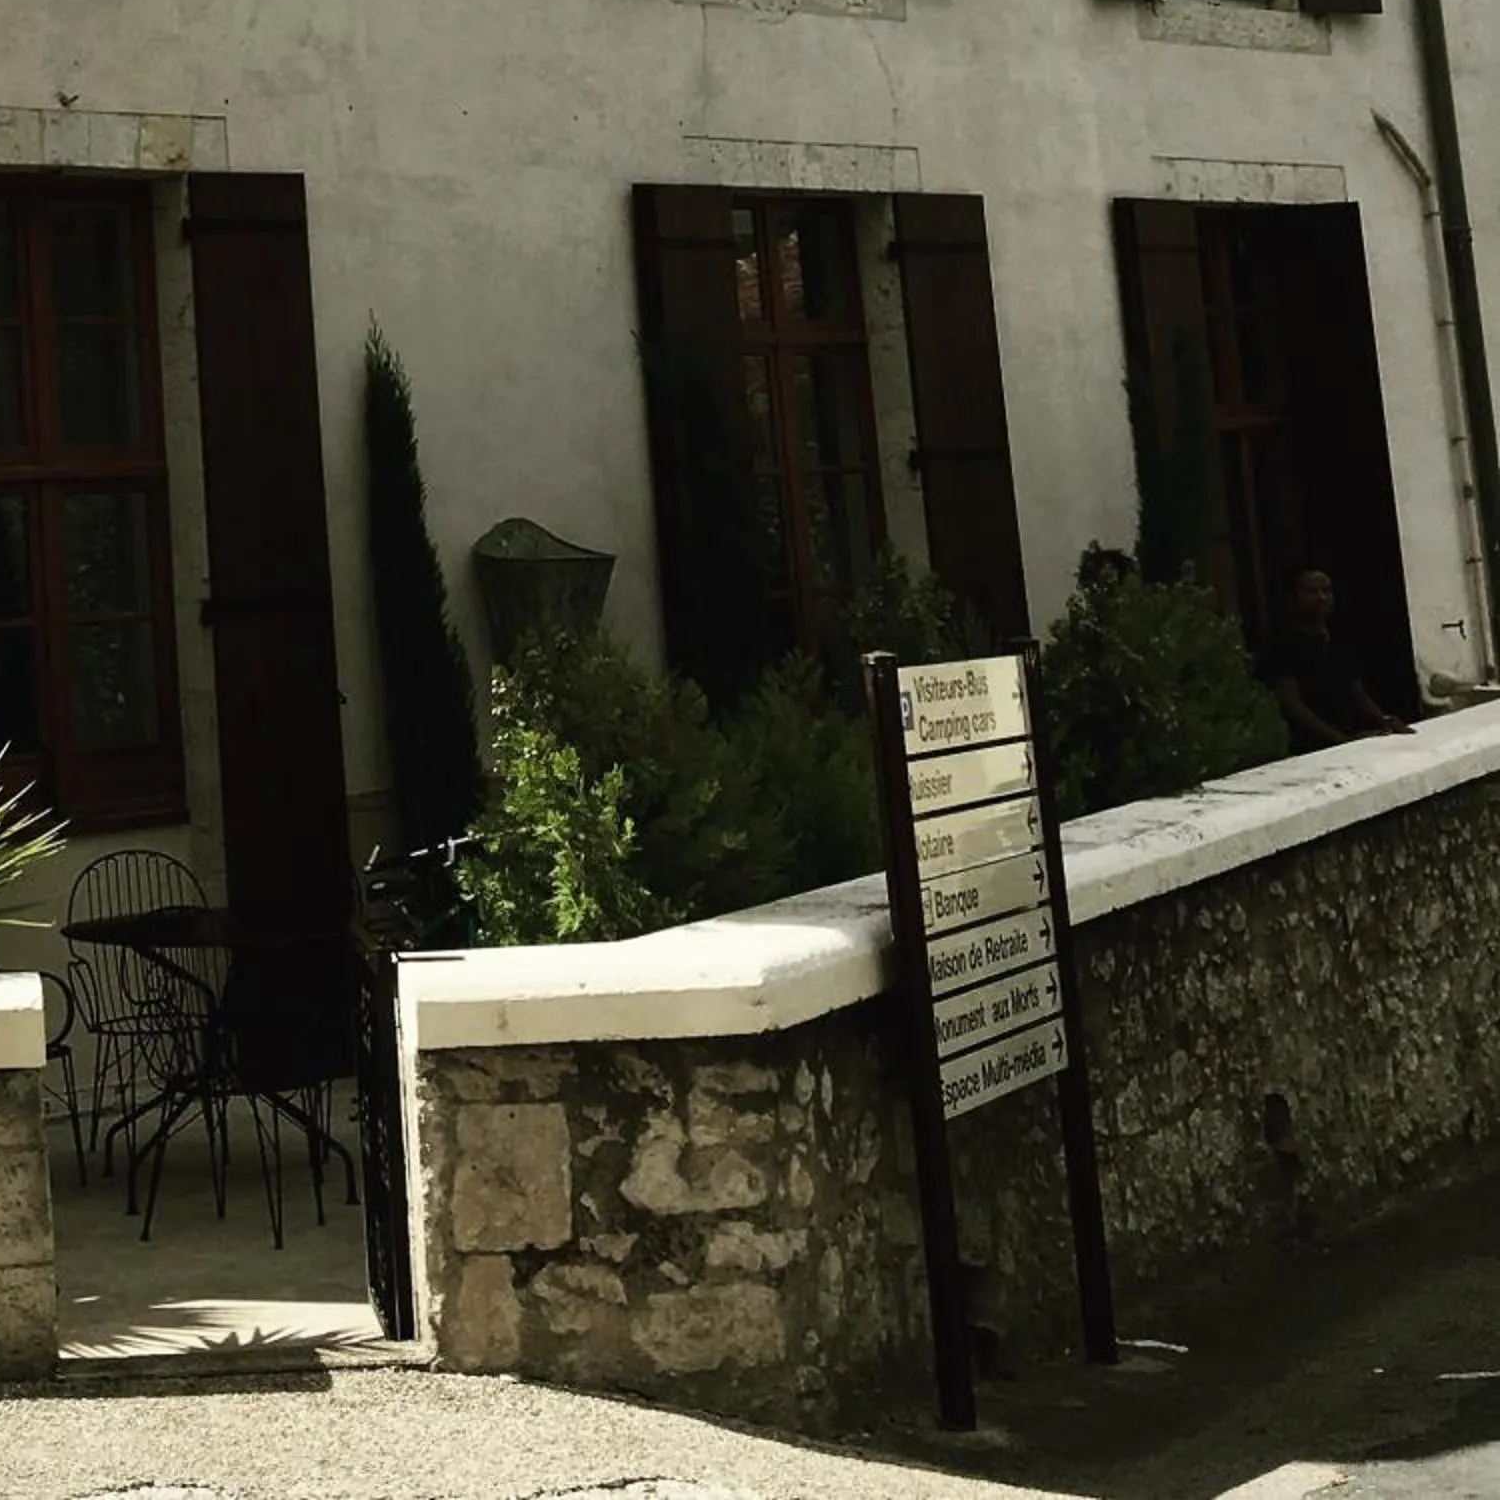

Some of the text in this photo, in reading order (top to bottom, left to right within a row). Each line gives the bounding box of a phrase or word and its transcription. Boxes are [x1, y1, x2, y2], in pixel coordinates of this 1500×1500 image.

[919, 710, 997, 744] Camping cars
[909, 769, 952, 802] uissier
[916, 830, 954, 862] otaire
[934, 887, 979, 919] Banque
[968, 940, 983, 969] de
[985, 928, 1029, 965] Retraite
[991, 1001, 1011, 1023] aux
[1010, 983, 1040, 1015] Morts
